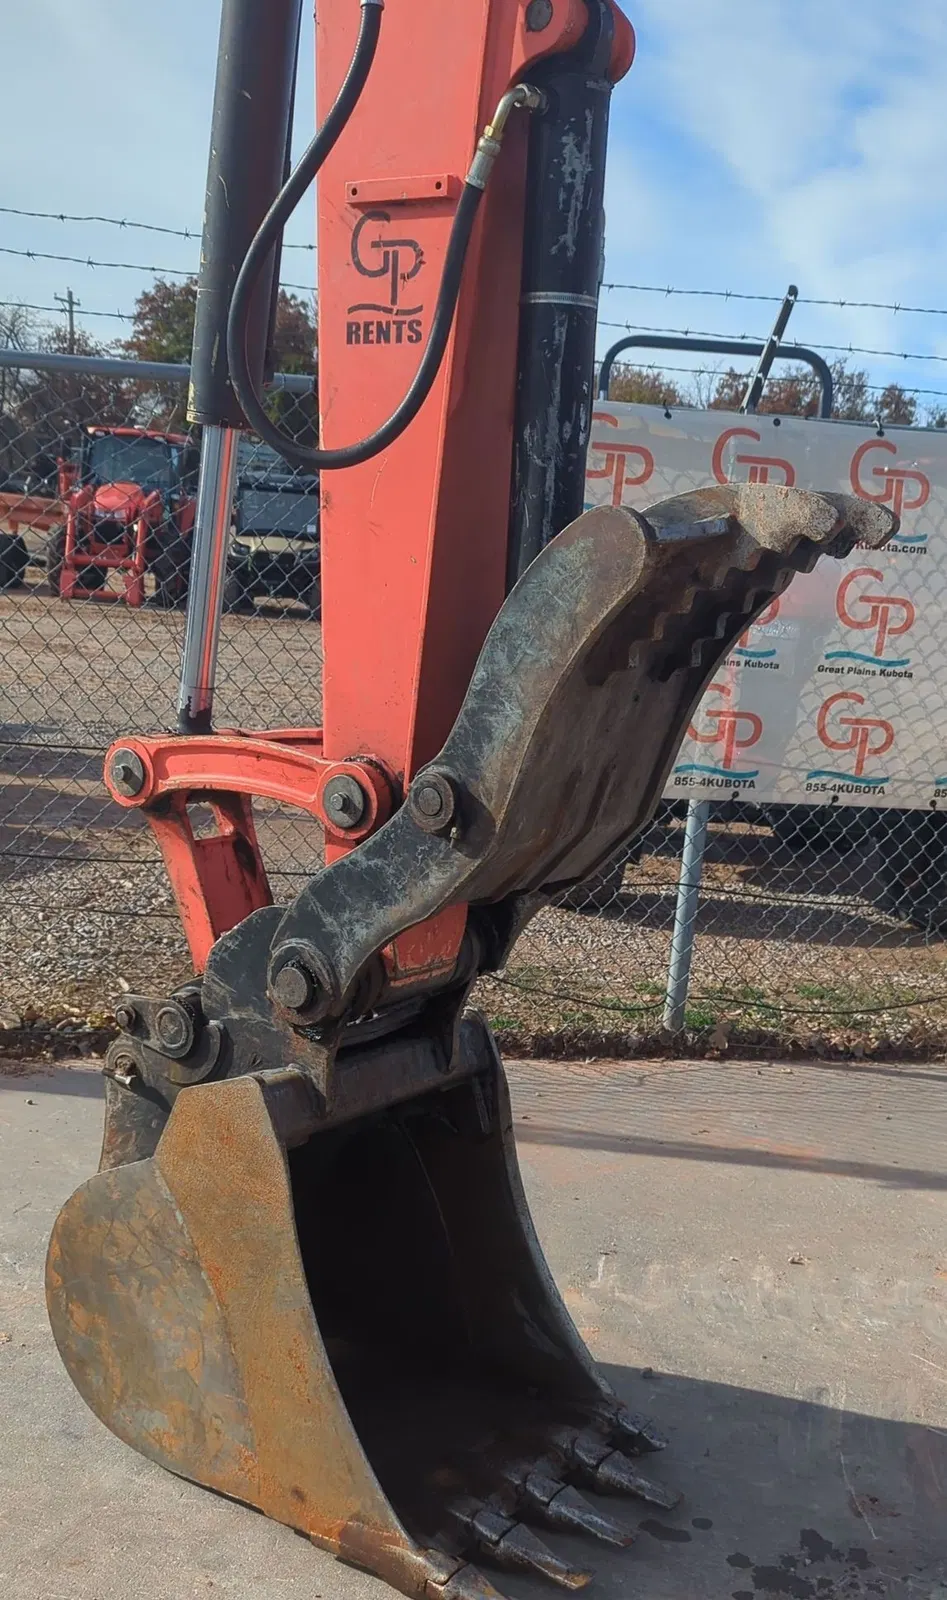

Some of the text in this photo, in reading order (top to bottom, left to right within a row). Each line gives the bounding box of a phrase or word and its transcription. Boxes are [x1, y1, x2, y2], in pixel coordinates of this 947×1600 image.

[346, 319, 423, 345] RENTS
[836, 567, 915, 657] GP
[744, 659, 780, 670] Kubota
[817, 664, 914, 679] Great Plains Kubota
[816, 691, 895, 777] GP
[673, 776, 756, 789] 855-4KUBOTA
[805, 782, 886, 796] 855-4KUBOTA
